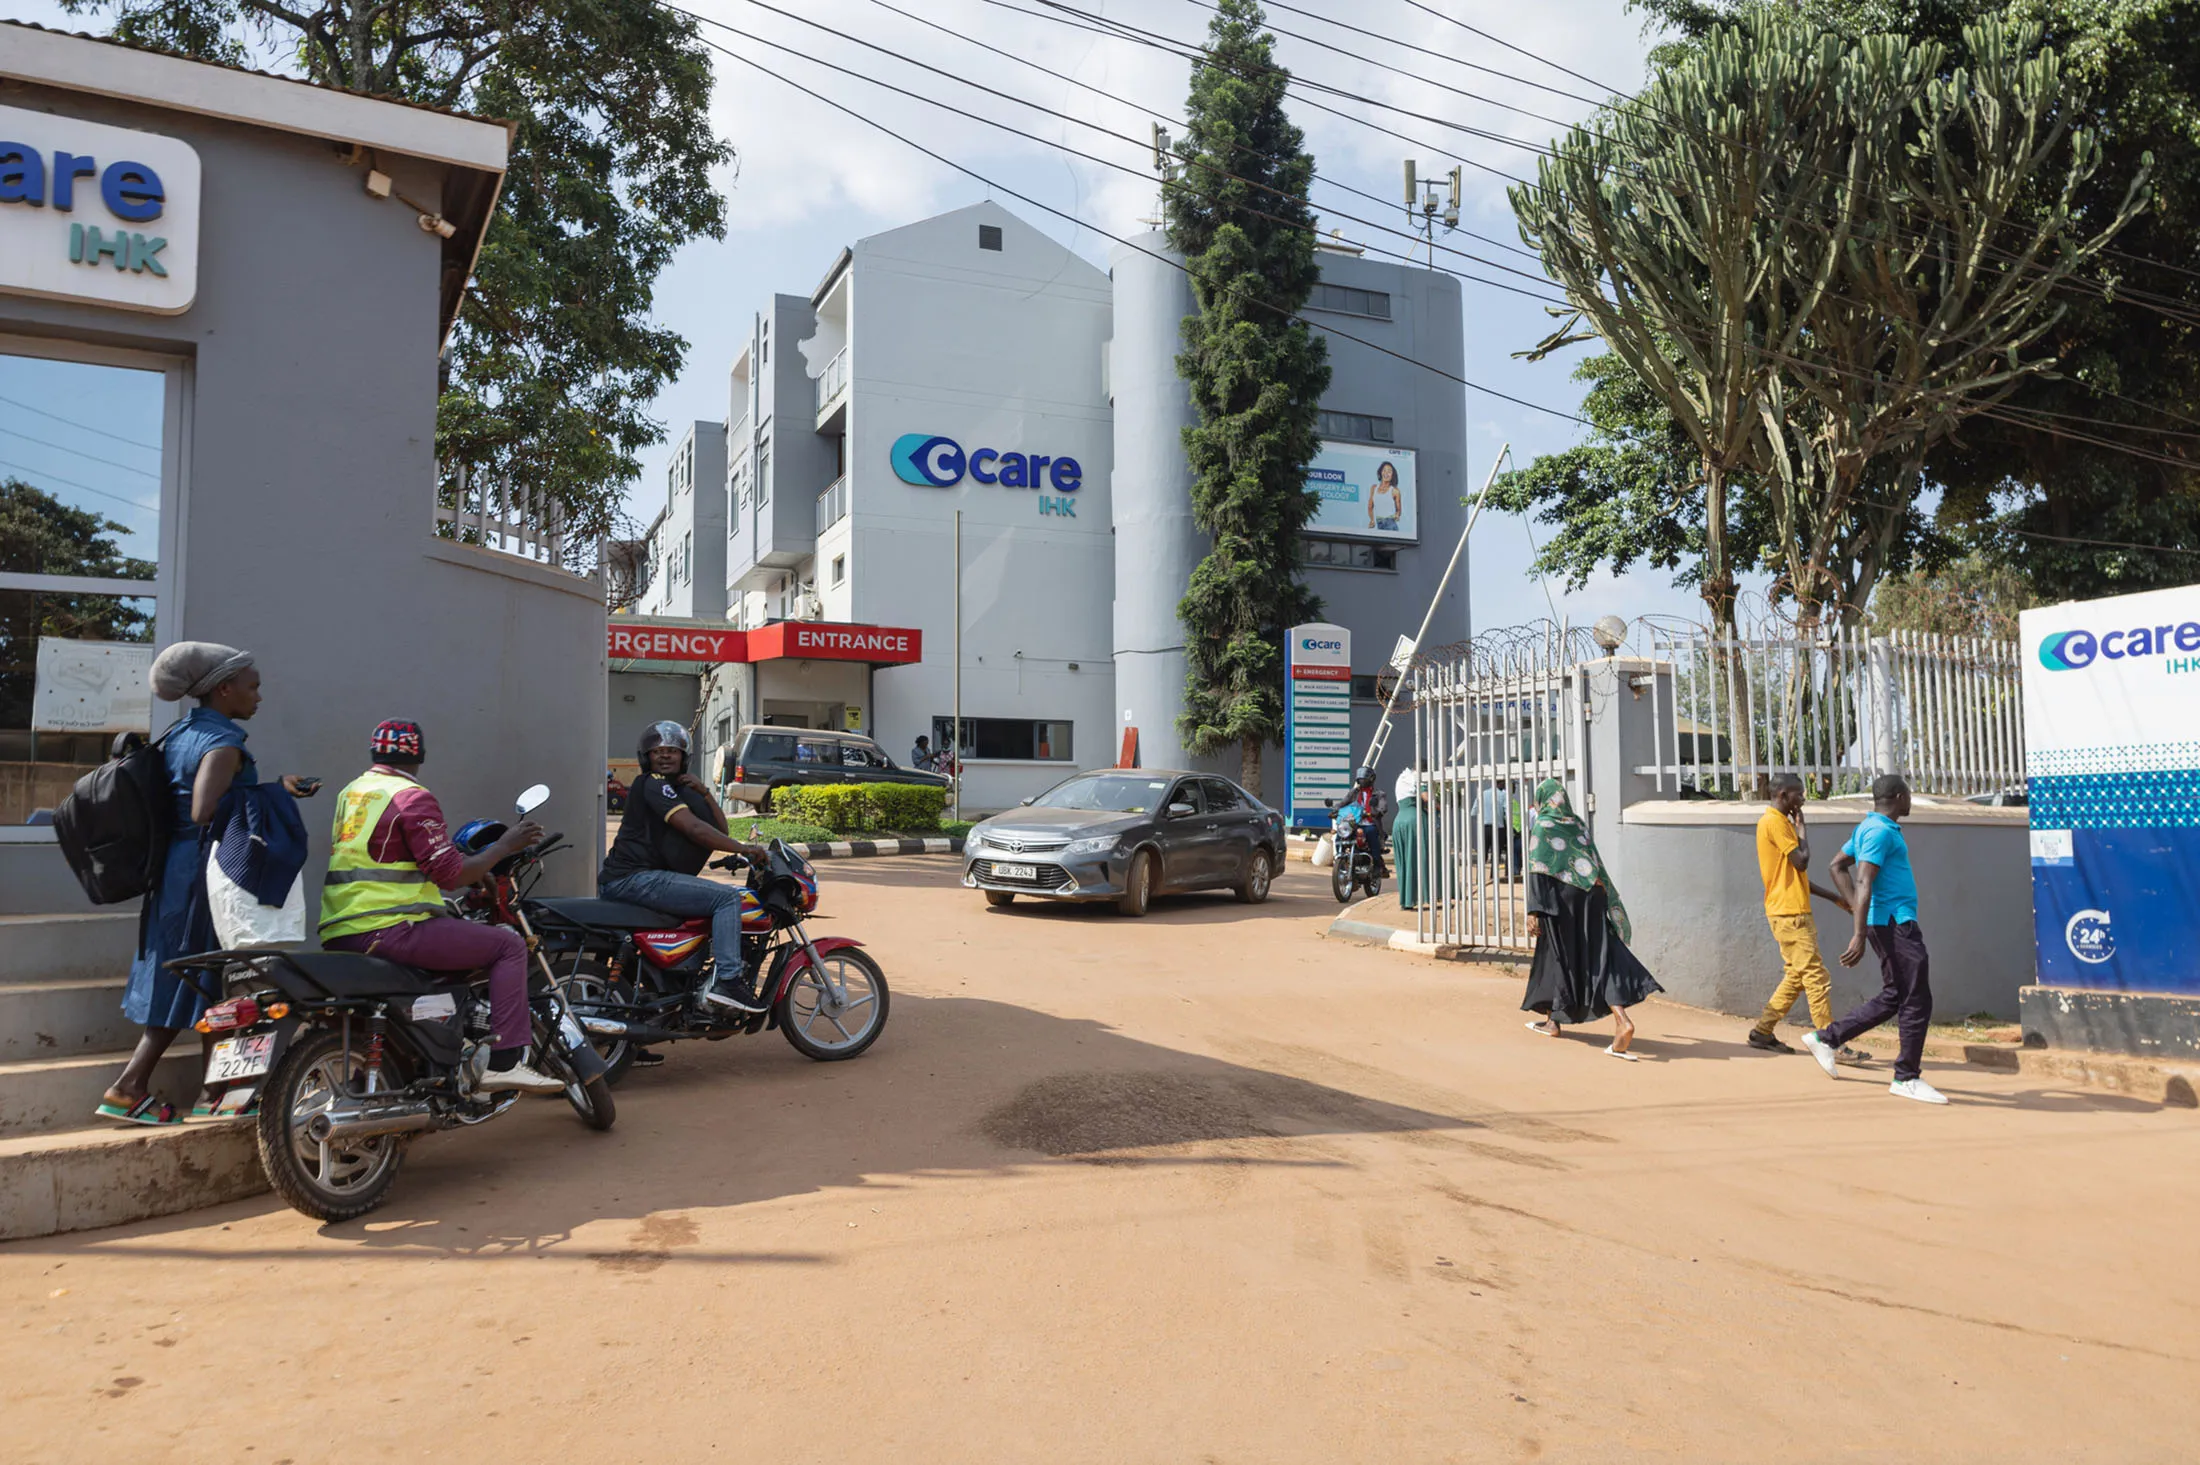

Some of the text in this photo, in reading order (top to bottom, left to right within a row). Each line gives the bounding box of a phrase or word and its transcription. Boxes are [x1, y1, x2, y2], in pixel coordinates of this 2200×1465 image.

[70, 223, 168, 278] IHK
[969, 447, 1082, 492] care
[1307, 471, 1343, 481] OUR LOOK
[1319, 491, 1350, 500] TOLOGY
[1341, 485, 1357, 494] AND
[1039, 495, 1076, 518] IHK
[798, 631, 908, 651] ENTRANCE
[1317, 640, 1341, 650] care
[2101, 622, 2200, 659] care
[1303, 668, 1339, 676] EMERGENCY
[233, 1035, 267, 1056] UFZ
